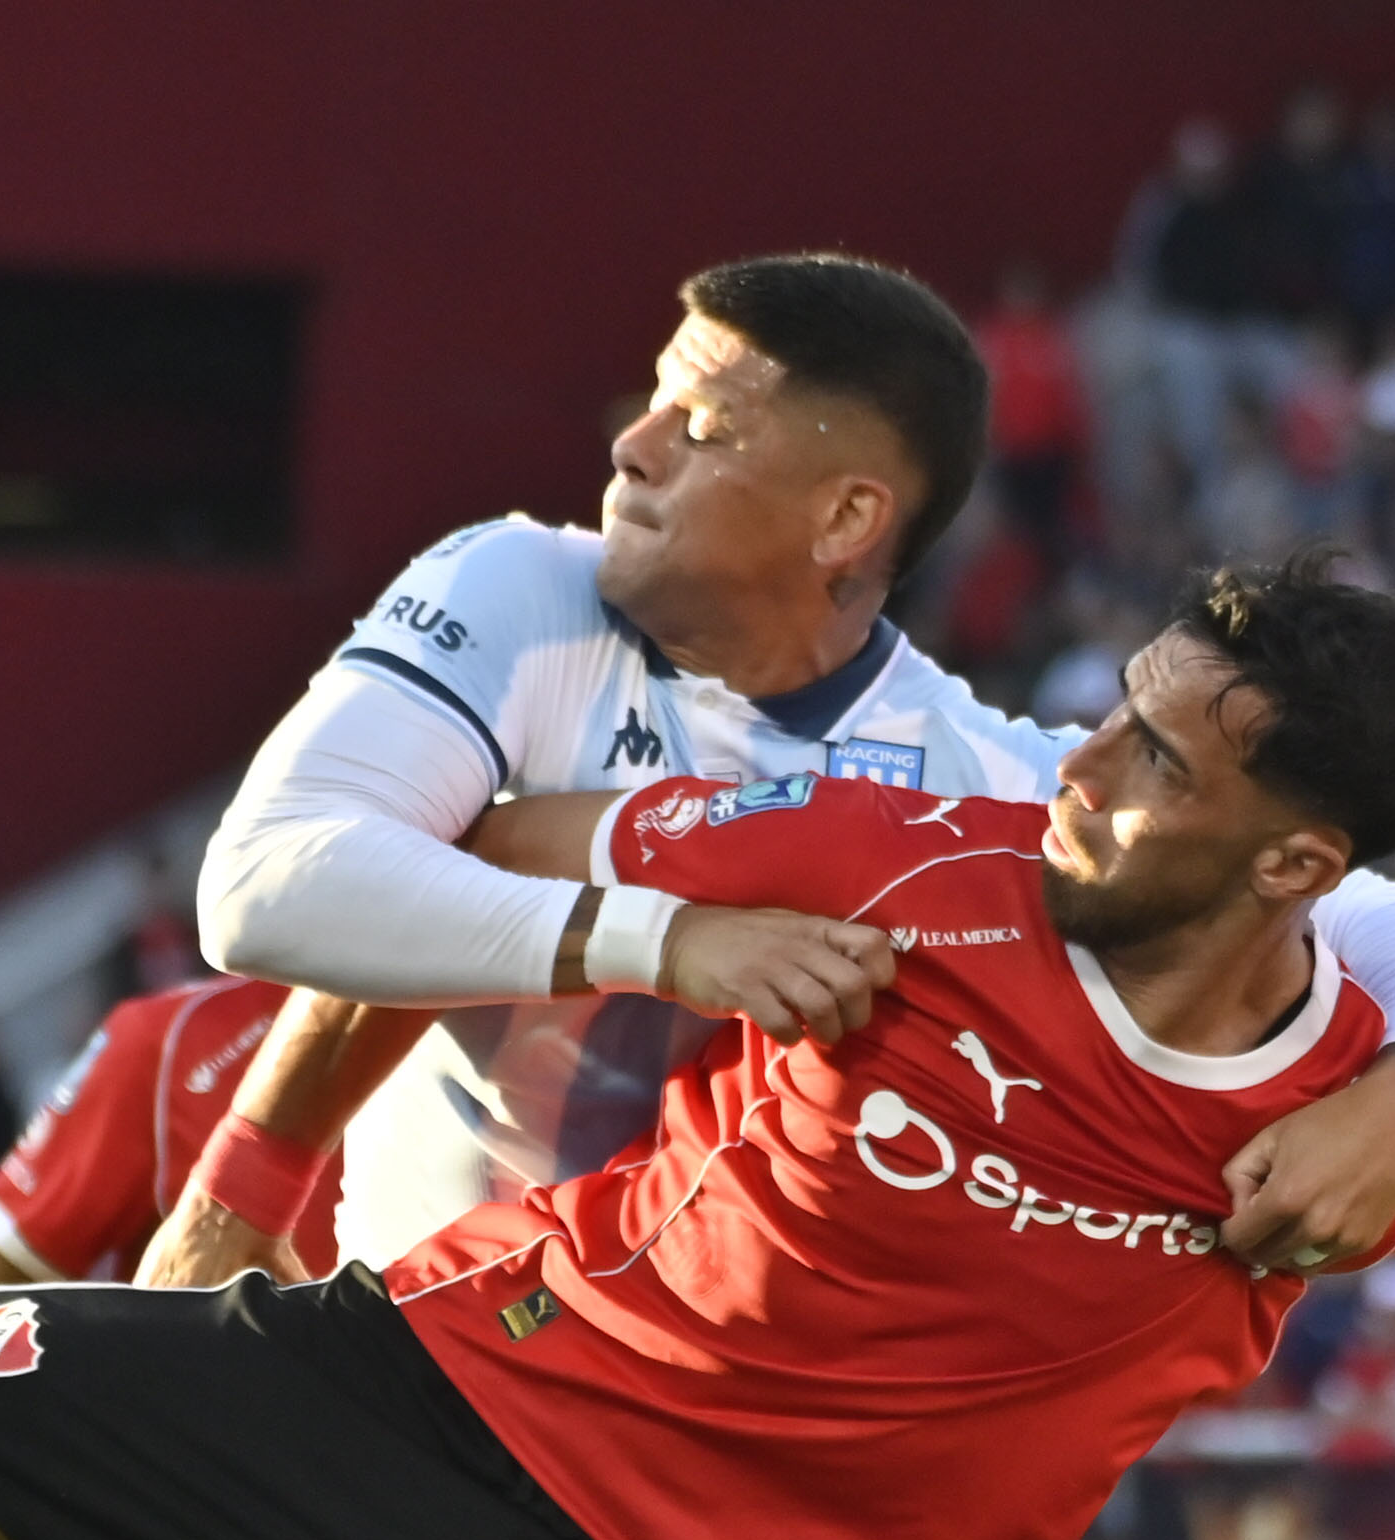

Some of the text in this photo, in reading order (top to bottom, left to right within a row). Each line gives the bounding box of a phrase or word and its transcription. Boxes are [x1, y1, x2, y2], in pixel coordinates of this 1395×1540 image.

[382, 595, 469, 652] RUS
[835, 748, 916, 769] RACING
[921, 931, 962, 947] LEAL
[963, 1153, 1269, 1280] Sports
